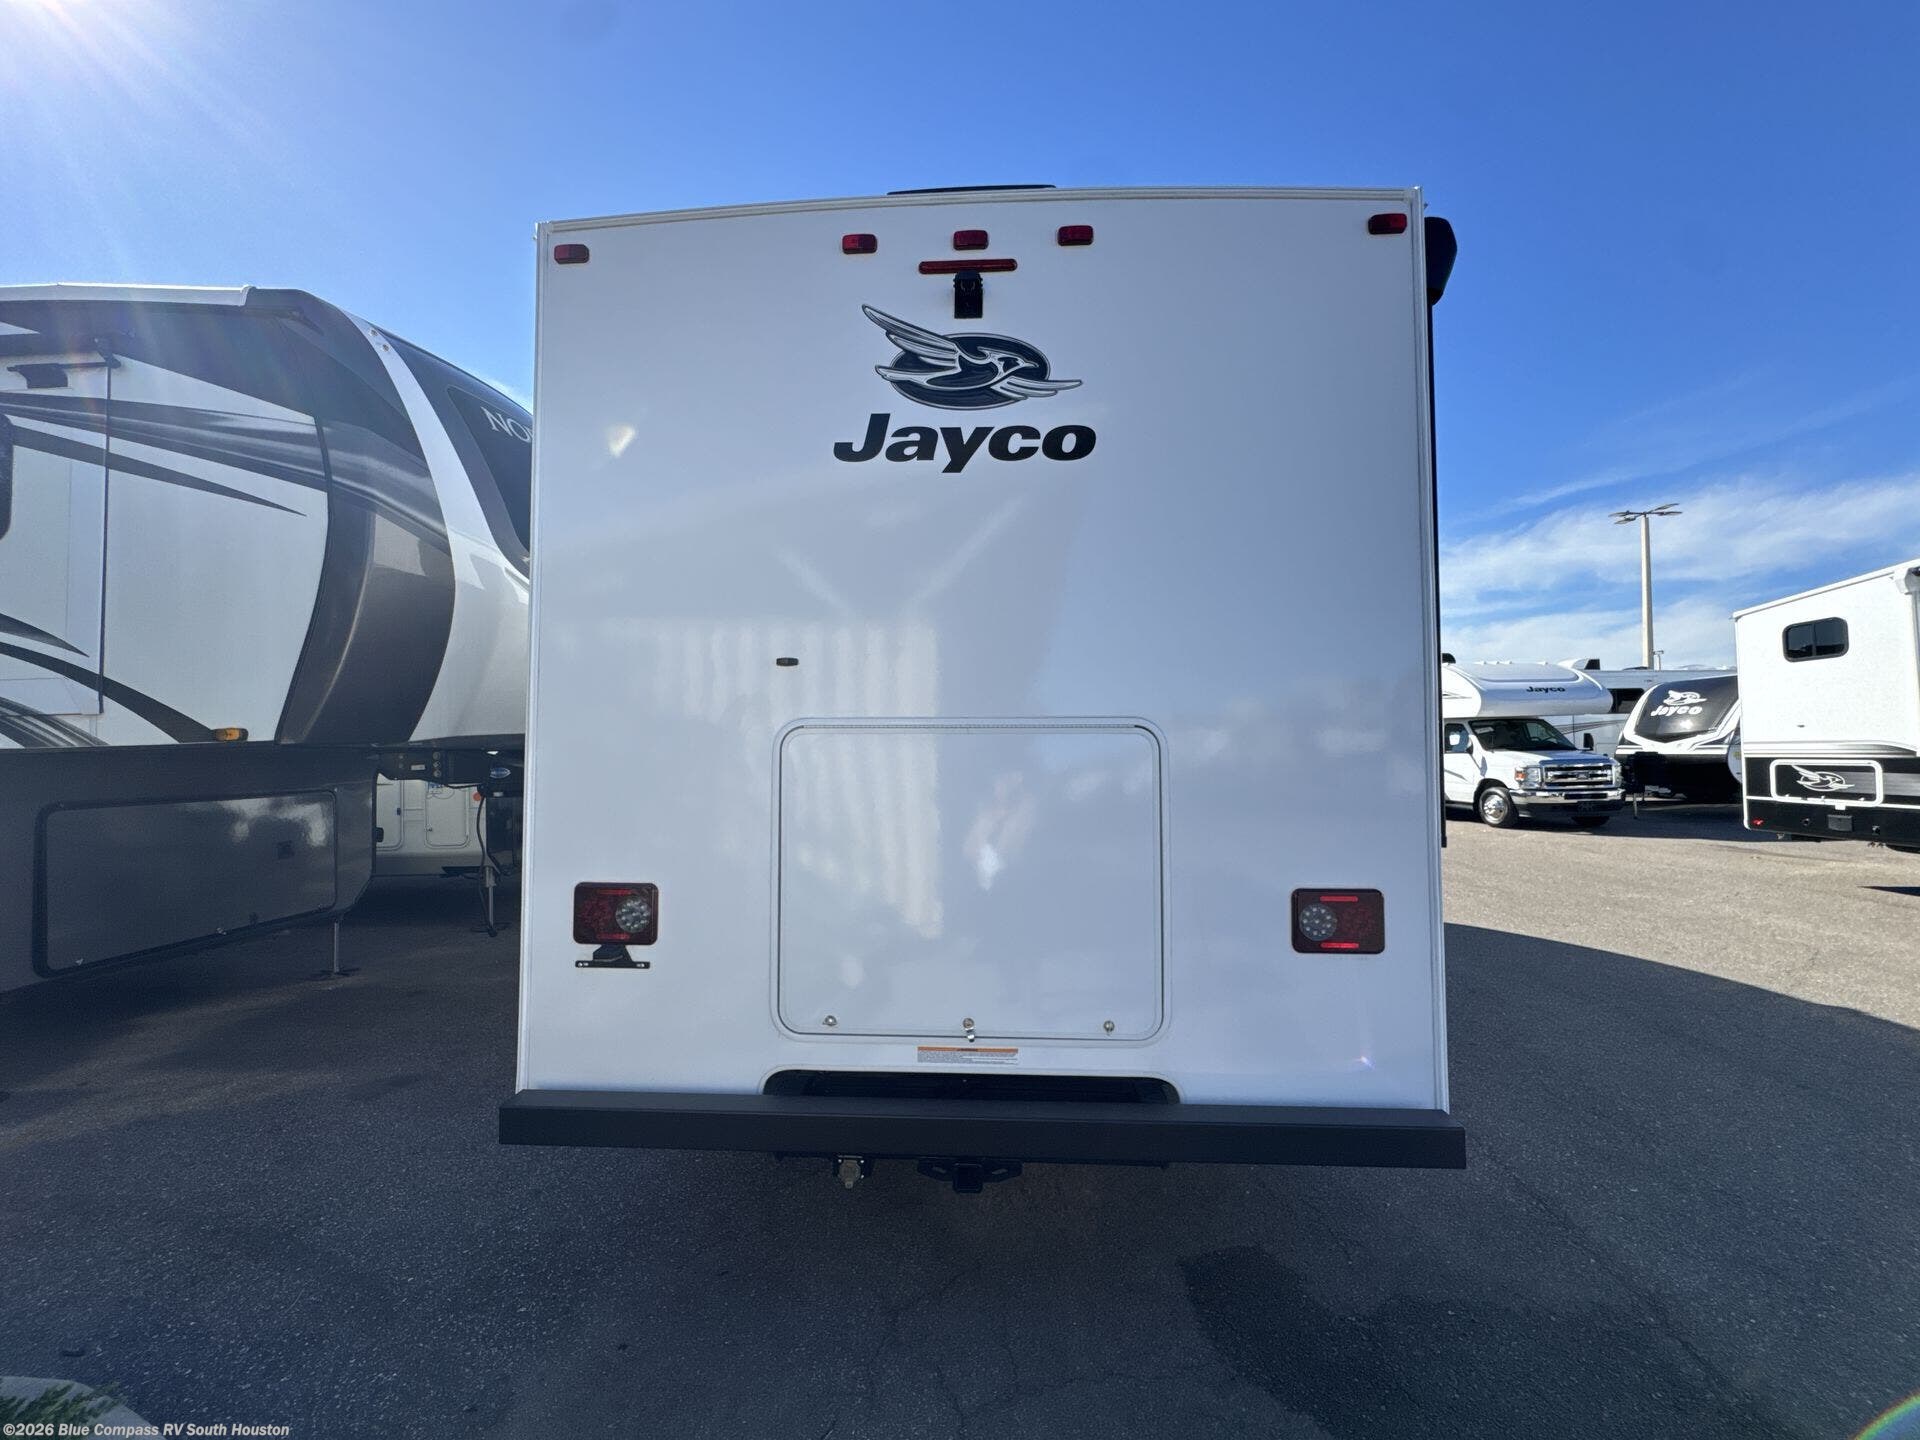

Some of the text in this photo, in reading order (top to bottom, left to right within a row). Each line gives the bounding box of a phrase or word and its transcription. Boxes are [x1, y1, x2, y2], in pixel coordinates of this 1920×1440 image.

[833, 413, 1097, 474] Jayco
[1526, 686, 1566, 694] Jayco
[1650, 705, 1703, 717] Jayco
